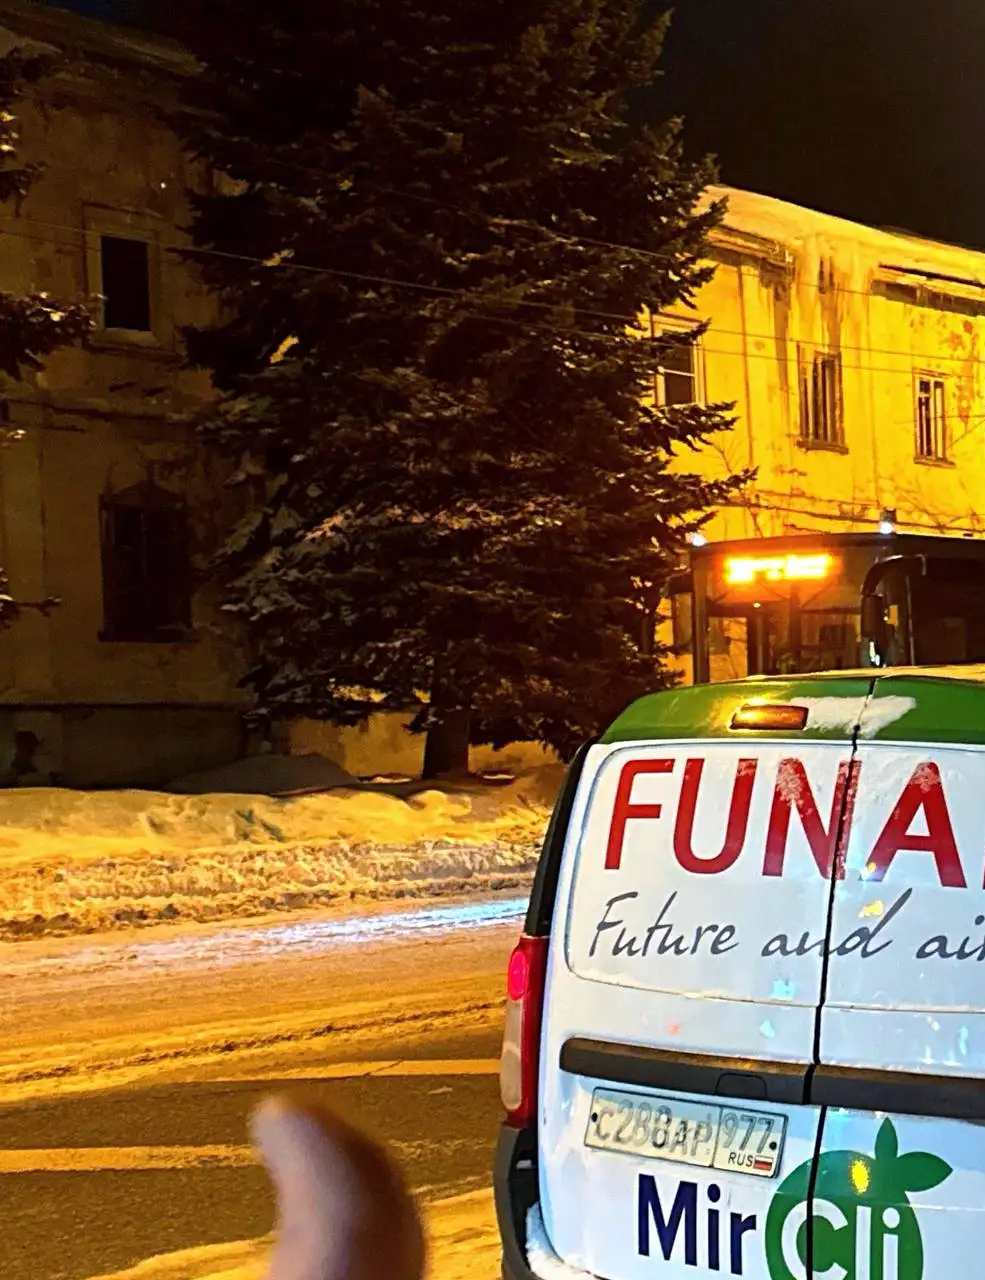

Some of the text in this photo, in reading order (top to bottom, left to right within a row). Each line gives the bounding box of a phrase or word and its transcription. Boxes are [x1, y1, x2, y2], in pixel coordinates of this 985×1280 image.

[589, 890, 740, 958] Future
[761, 887, 914, 959] and
[728, 1151, 754, 1168] RUS
